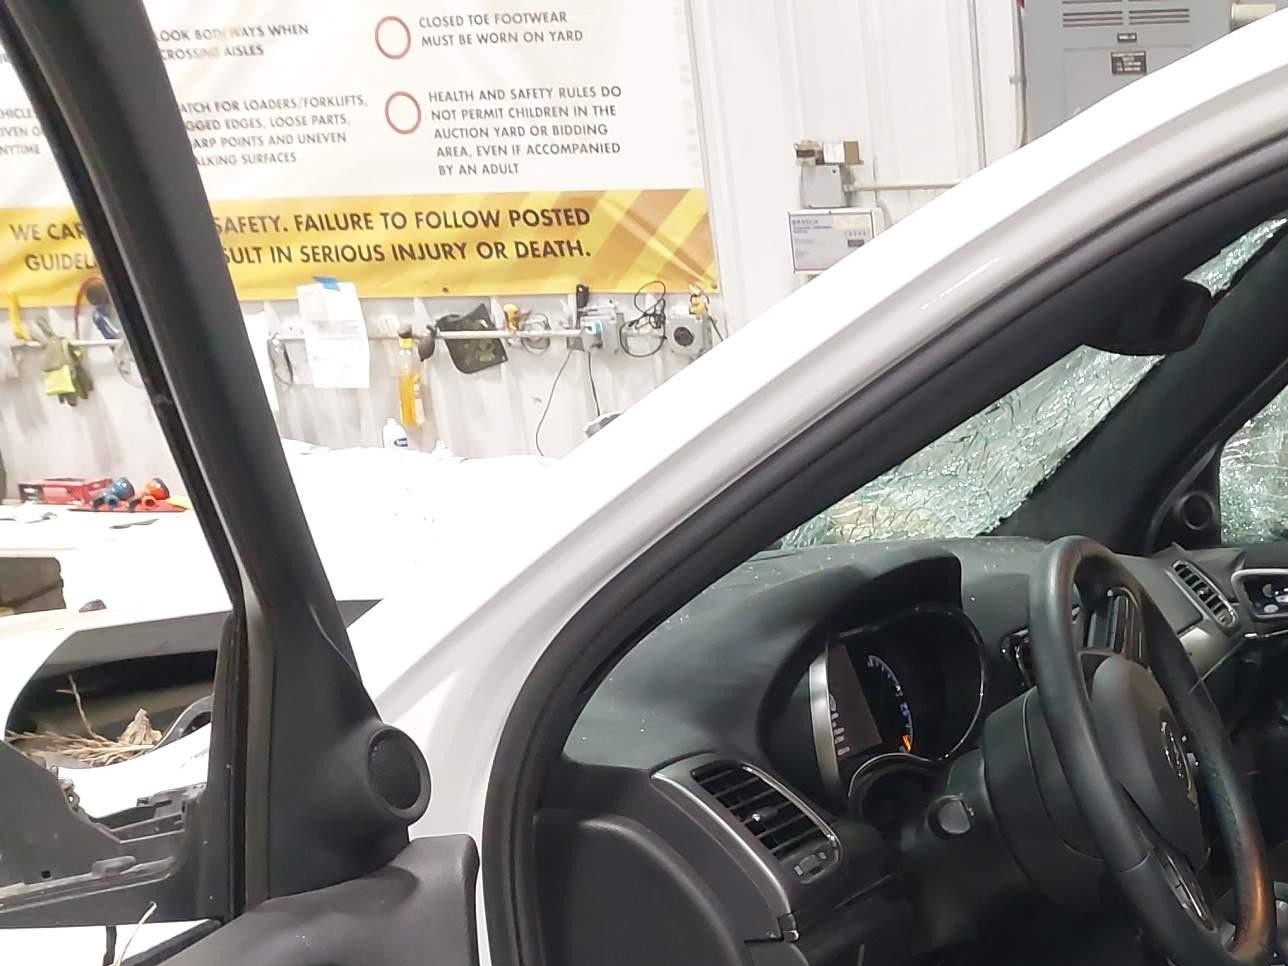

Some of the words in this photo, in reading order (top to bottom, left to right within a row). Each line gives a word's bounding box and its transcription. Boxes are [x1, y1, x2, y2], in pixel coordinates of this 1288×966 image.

[418, 15, 464, 28] CLOSED
[468, 14, 490, 26] TOE
[494, 11, 568, 25] FOOTWEAR
[267, 24, 309, 38] WHEN
[421, 34, 454, 48] MUST
[458, 32, 473, 46] BE
[477, 30, 519, 44] WORN
[523, 30, 545, 44] ON
[548, 29, 583, 42] YARD
[224, 44, 264, 58] AISLES
[428, 89, 474, 104] HEALTH
[478, 88, 506, 102] AND
[510, 87, 554, 100] SAFETY
[558, 85, 597, 99] RULES
[600, 84, 622, 98] DO
[215, 100, 240, 113] FOR
[431, 108, 457, 122] NOT
[461, 106, 504, 120] PERMIT
[508, 104, 569, 118] CHILDREN
[573, 104, 588, 117] IN
[592, 104, 617, 117] THE
[225, 117, 268, 132] EDGES,
[270, 115, 308, 128] LOOSE
[312, 113, 350, 126] PARTS,
[434, 126, 489, 140] AUCTION
[494, 125, 525, 138] YARD
[530, 124, 548, 138] OR
[552, 122, 608, 136] BIDDING
[220, 135, 264, 148] POINTS
[268, 134, 294, 147] AND
[298, 132, 347, 146] UNEVEN
[436, 144, 472, 158] AREA,
[476, 144, 508, 157] EVEN
[512, 144, 523, 157] IF
[526, 142, 622, 156] ACCOMPANIED
[242, 152, 297, 166] SURFACES
[438, 164, 454, 177] BY
[458, 163, 478, 176] AN
[482, 162, 520, 176] ADULT
[9, 223, 41, 242] WE
[293, 212, 374, 232] FAILURE
[380, 210, 407, 230] TO
[415, 209, 500, 230] FOLLOW
[509, 208, 590, 228] POSTED
[24, 252, 98, 272] GUIDEL
[271, 244, 292, 264] IN
[300, 243, 386, 264] SERIOUS
[392, 241, 467, 262] INJURY
[476, 240, 508, 260] OR
[516, 239, 591, 260] DEATH.
